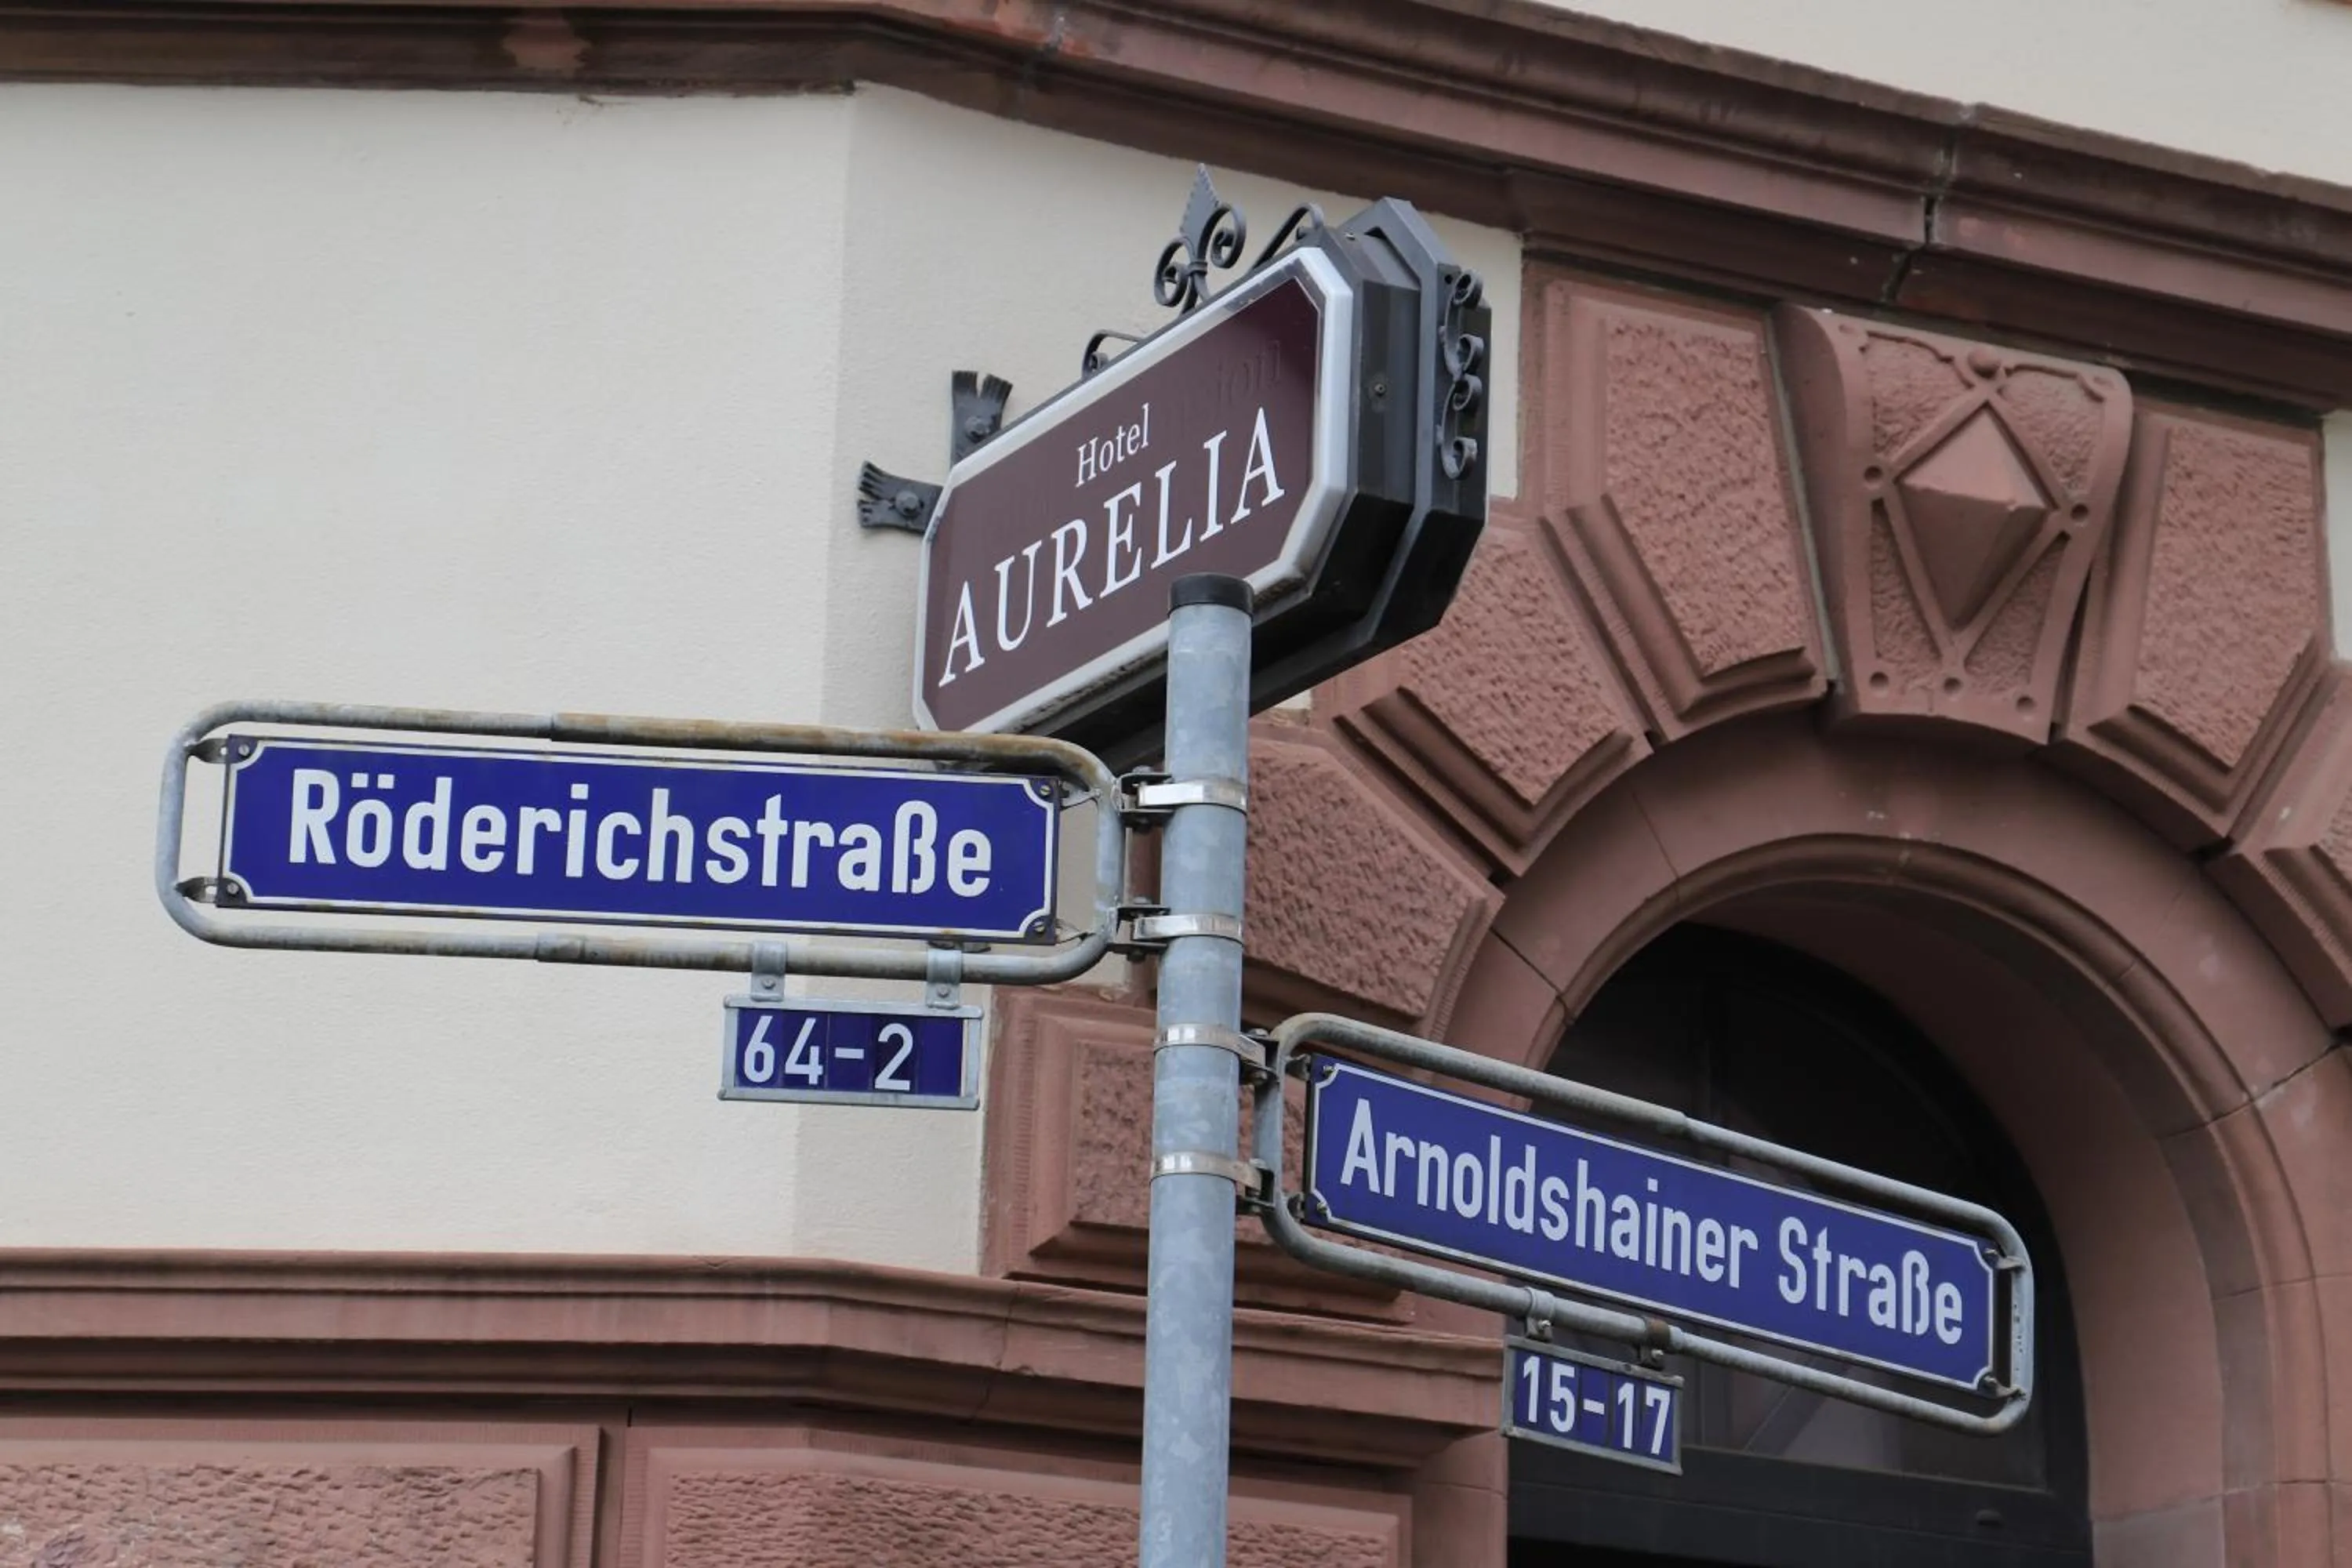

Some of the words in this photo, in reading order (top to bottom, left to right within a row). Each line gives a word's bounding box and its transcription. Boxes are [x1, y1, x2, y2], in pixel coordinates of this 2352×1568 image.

[1075, 402, 1150, 488] Hotel
[938, 406, 1286, 688] AURELIA
[289, 768, 993, 898] Röderichstraße
[744, 1015, 914, 1091] 64-2
[1339, 1098, 1759, 1289] Arnoldshainer
[1777, 1215, 1963, 1345] Straße
[1523, 1356, 1671, 1455] 15-17
